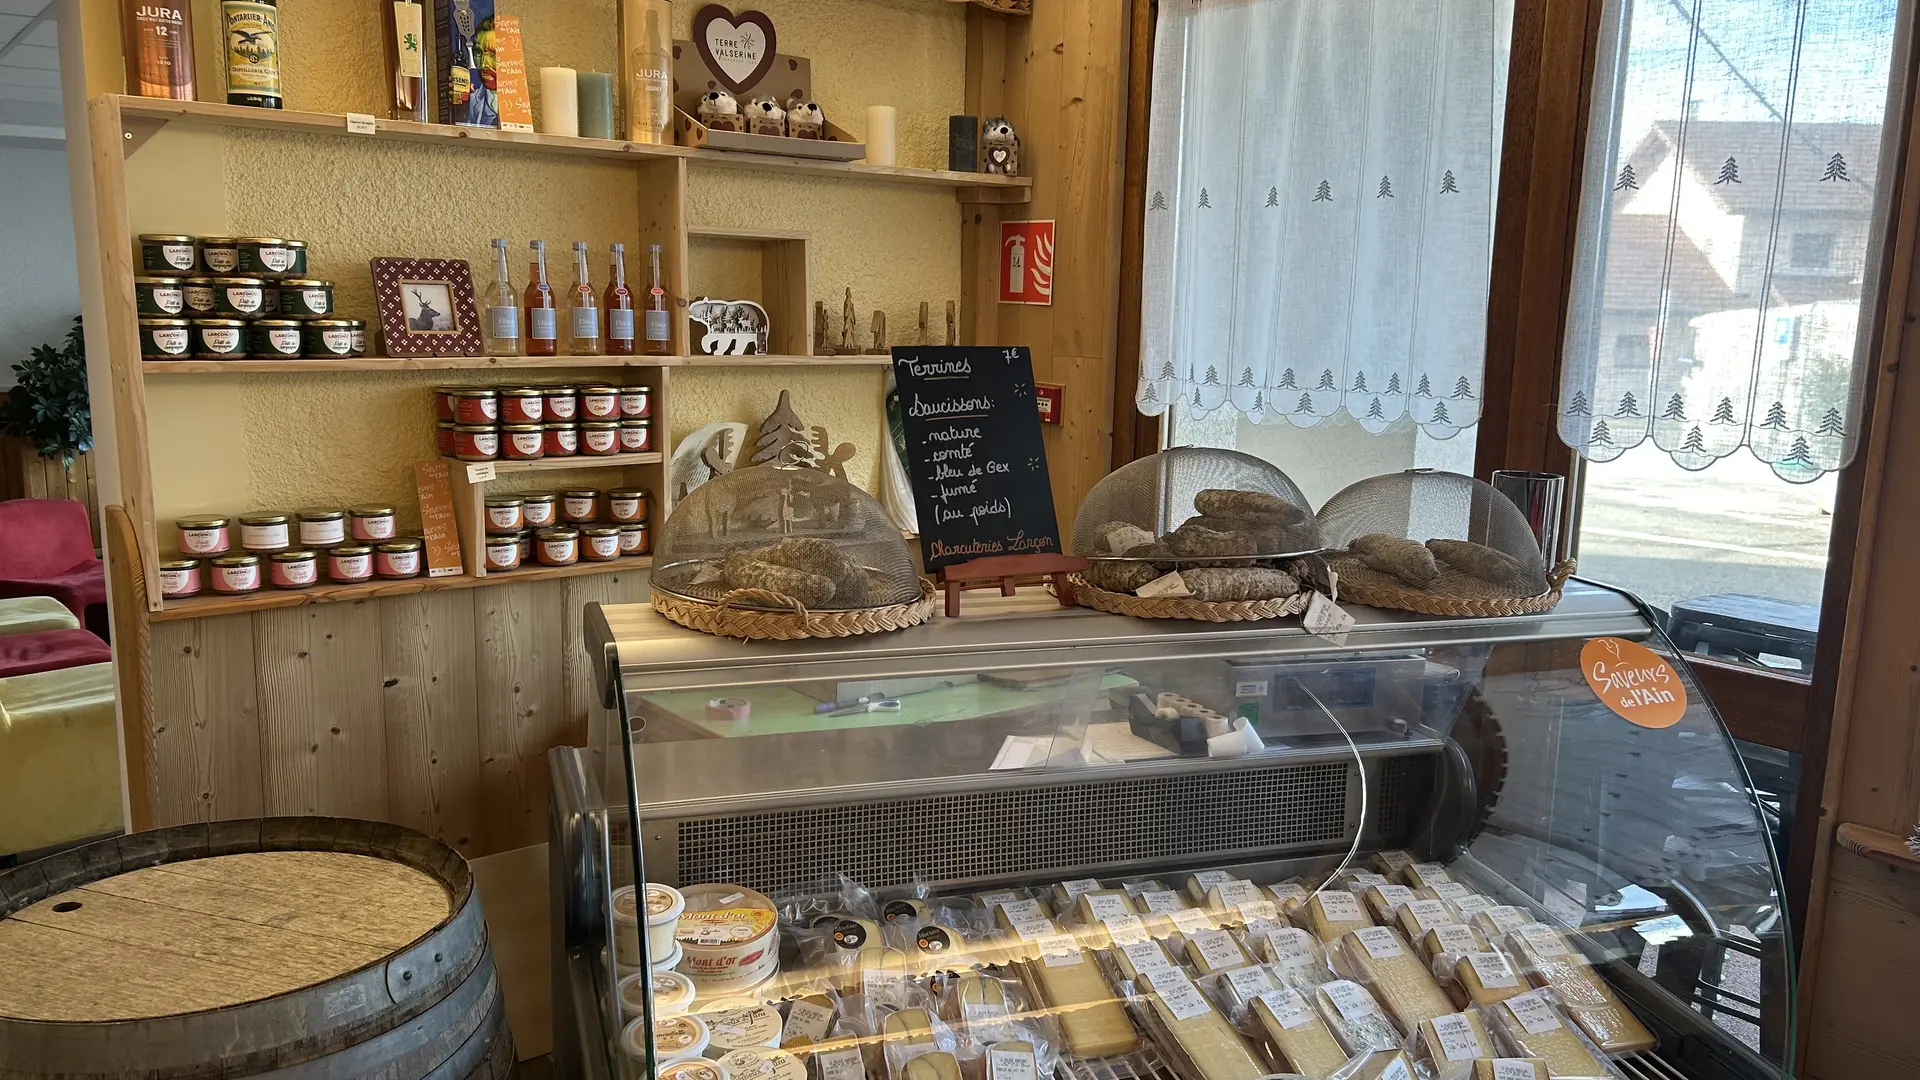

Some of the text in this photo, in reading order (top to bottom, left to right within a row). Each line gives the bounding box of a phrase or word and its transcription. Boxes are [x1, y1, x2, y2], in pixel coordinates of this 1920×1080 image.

[136, 5, 182, 20] JURA
[155, 26, 168, 36] 12
[715, 38, 738, 49] TERRE
[715, 48, 757, 60] VALSERINE
[635, 68, 668, 80] JURA
[898, 347, 1020, 377] Terrines 7€
[968, 464, 984, 478] de
[986, 461, 1010, 474] Gex
[934, 496, 1012, 526] (au poids)
[930, 539, 1003, 561] Charcuteries
[1592, 661, 1670, 694] Saveurs
[1620, 687, 1675, 708] de l'Ain
[679, 911, 749, 920] Mont d'or
[918, 929, 940, 938] Morbier
[686, 956, 738, 967] Mont d'or
